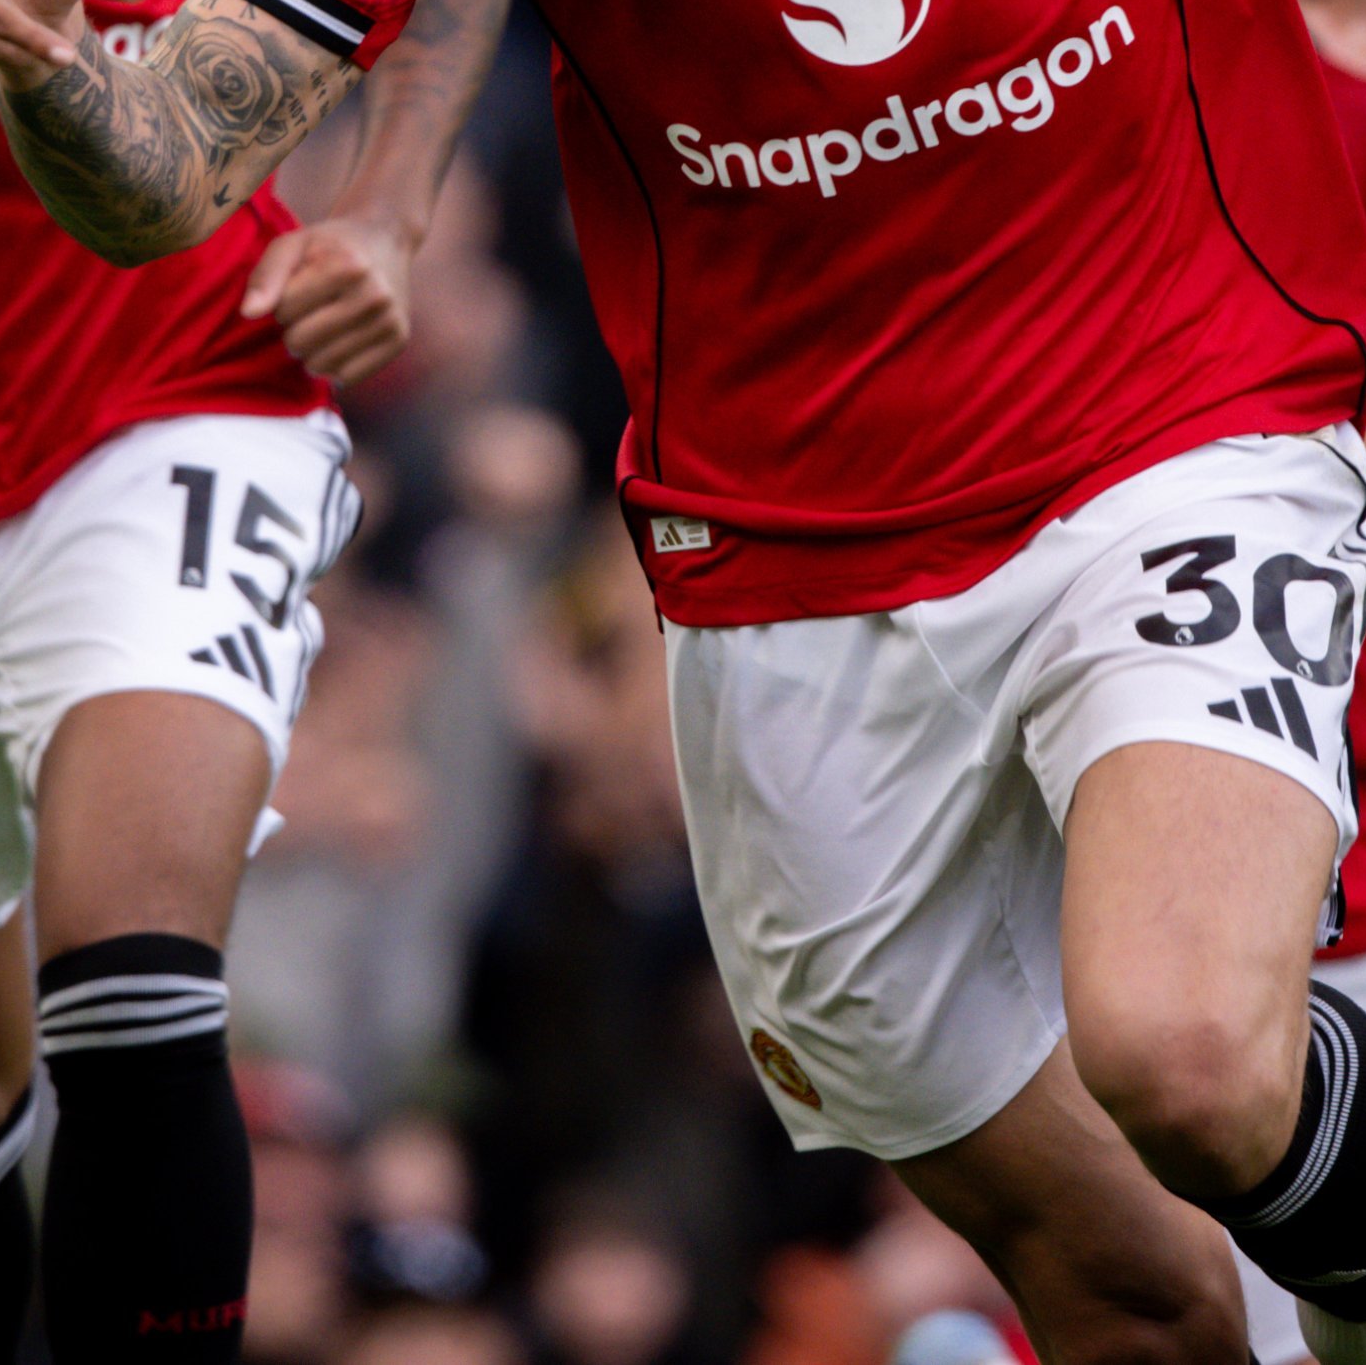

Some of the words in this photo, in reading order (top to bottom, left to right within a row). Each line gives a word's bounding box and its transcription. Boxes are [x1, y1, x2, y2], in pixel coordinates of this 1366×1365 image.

[666, 5, 1135, 198] Snapdragon
[170, 463, 306, 630] 15
[1135, 534, 1356, 688] 30
